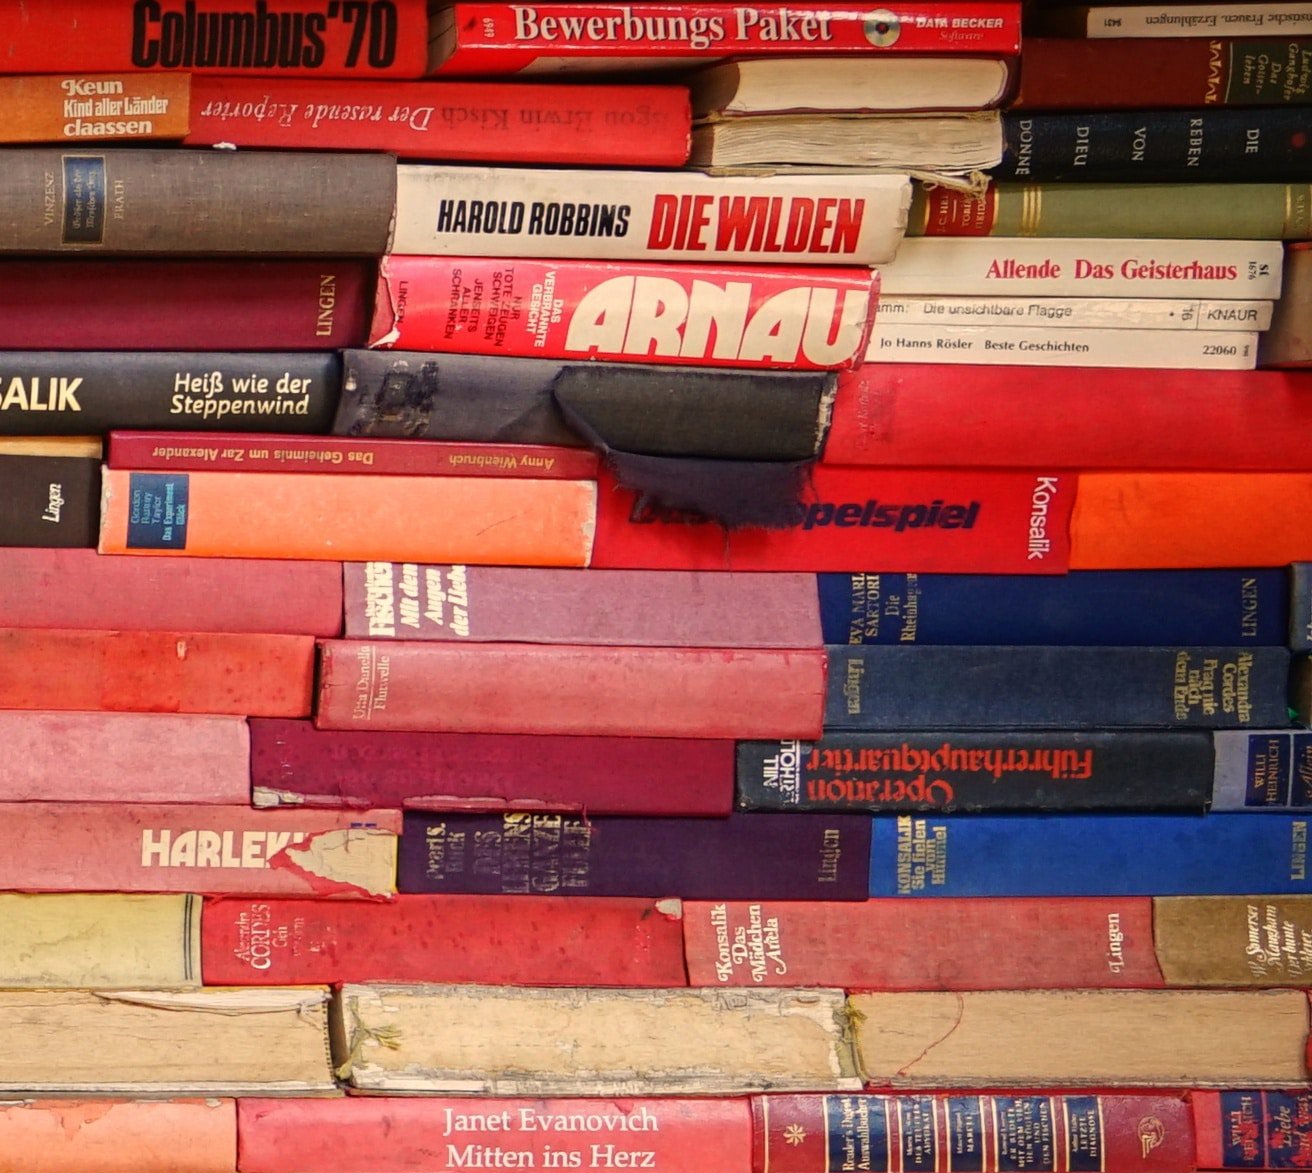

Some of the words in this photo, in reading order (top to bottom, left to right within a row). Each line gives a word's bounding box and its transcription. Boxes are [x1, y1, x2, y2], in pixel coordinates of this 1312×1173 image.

[132, 0, 324, 68] Columbus
[515, 8, 725, 48] Bewerbungs
[737, 8, 833, 42] Paket
[62, 79, 123, 96] Keun
[64, 99, 93, 117] Kind
[96, 99, 123, 116] aller
[126, 96, 168, 117] Länder
[64, 118, 152, 136] claassen
[438, 200, 523, 235] HAROLD
[529, 203, 630, 237] ROBBINS
[648, 194, 712, 251] DIE
[716, 198, 864, 254] WILDEN
[986, 258, 1061, 279] Allende
[1076, 258, 1114, 279] Das
[1121, 259, 1237, 281] Geisterhaus
[565, 275, 871, 368] ARNAU
[880, 338, 891, 350] Jo
[895, 338, 931, 350] Hanns
[937, 336, 973, 351] Rösler
[984, 339, 1014, 351] Beste
[1019, 339, 1089, 354] Geschichten
[1202, 344, 1237, 357] 22060
[175, 372, 223, 397] Heiß
[232, 375, 267, 392] wie
[274, 373, 311, 393] der
[171, 394, 308, 417] Steppenwind
[1028, 476, 1058, 560] Konsalik
[806, 743, 1094, 778] Führerhauptquartier
[807, 774, 954, 804] Operation
[1108, 913, 1124, 973] Lingen
[442, 1109, 511, 1136] Janet
[519, 1108, 658, 1132] Evanovich
[447, 1144, 534, 1168] Mitten
[542, 1145, 582, 1168] ins
[590, 1144, 656, 1168] Herz
